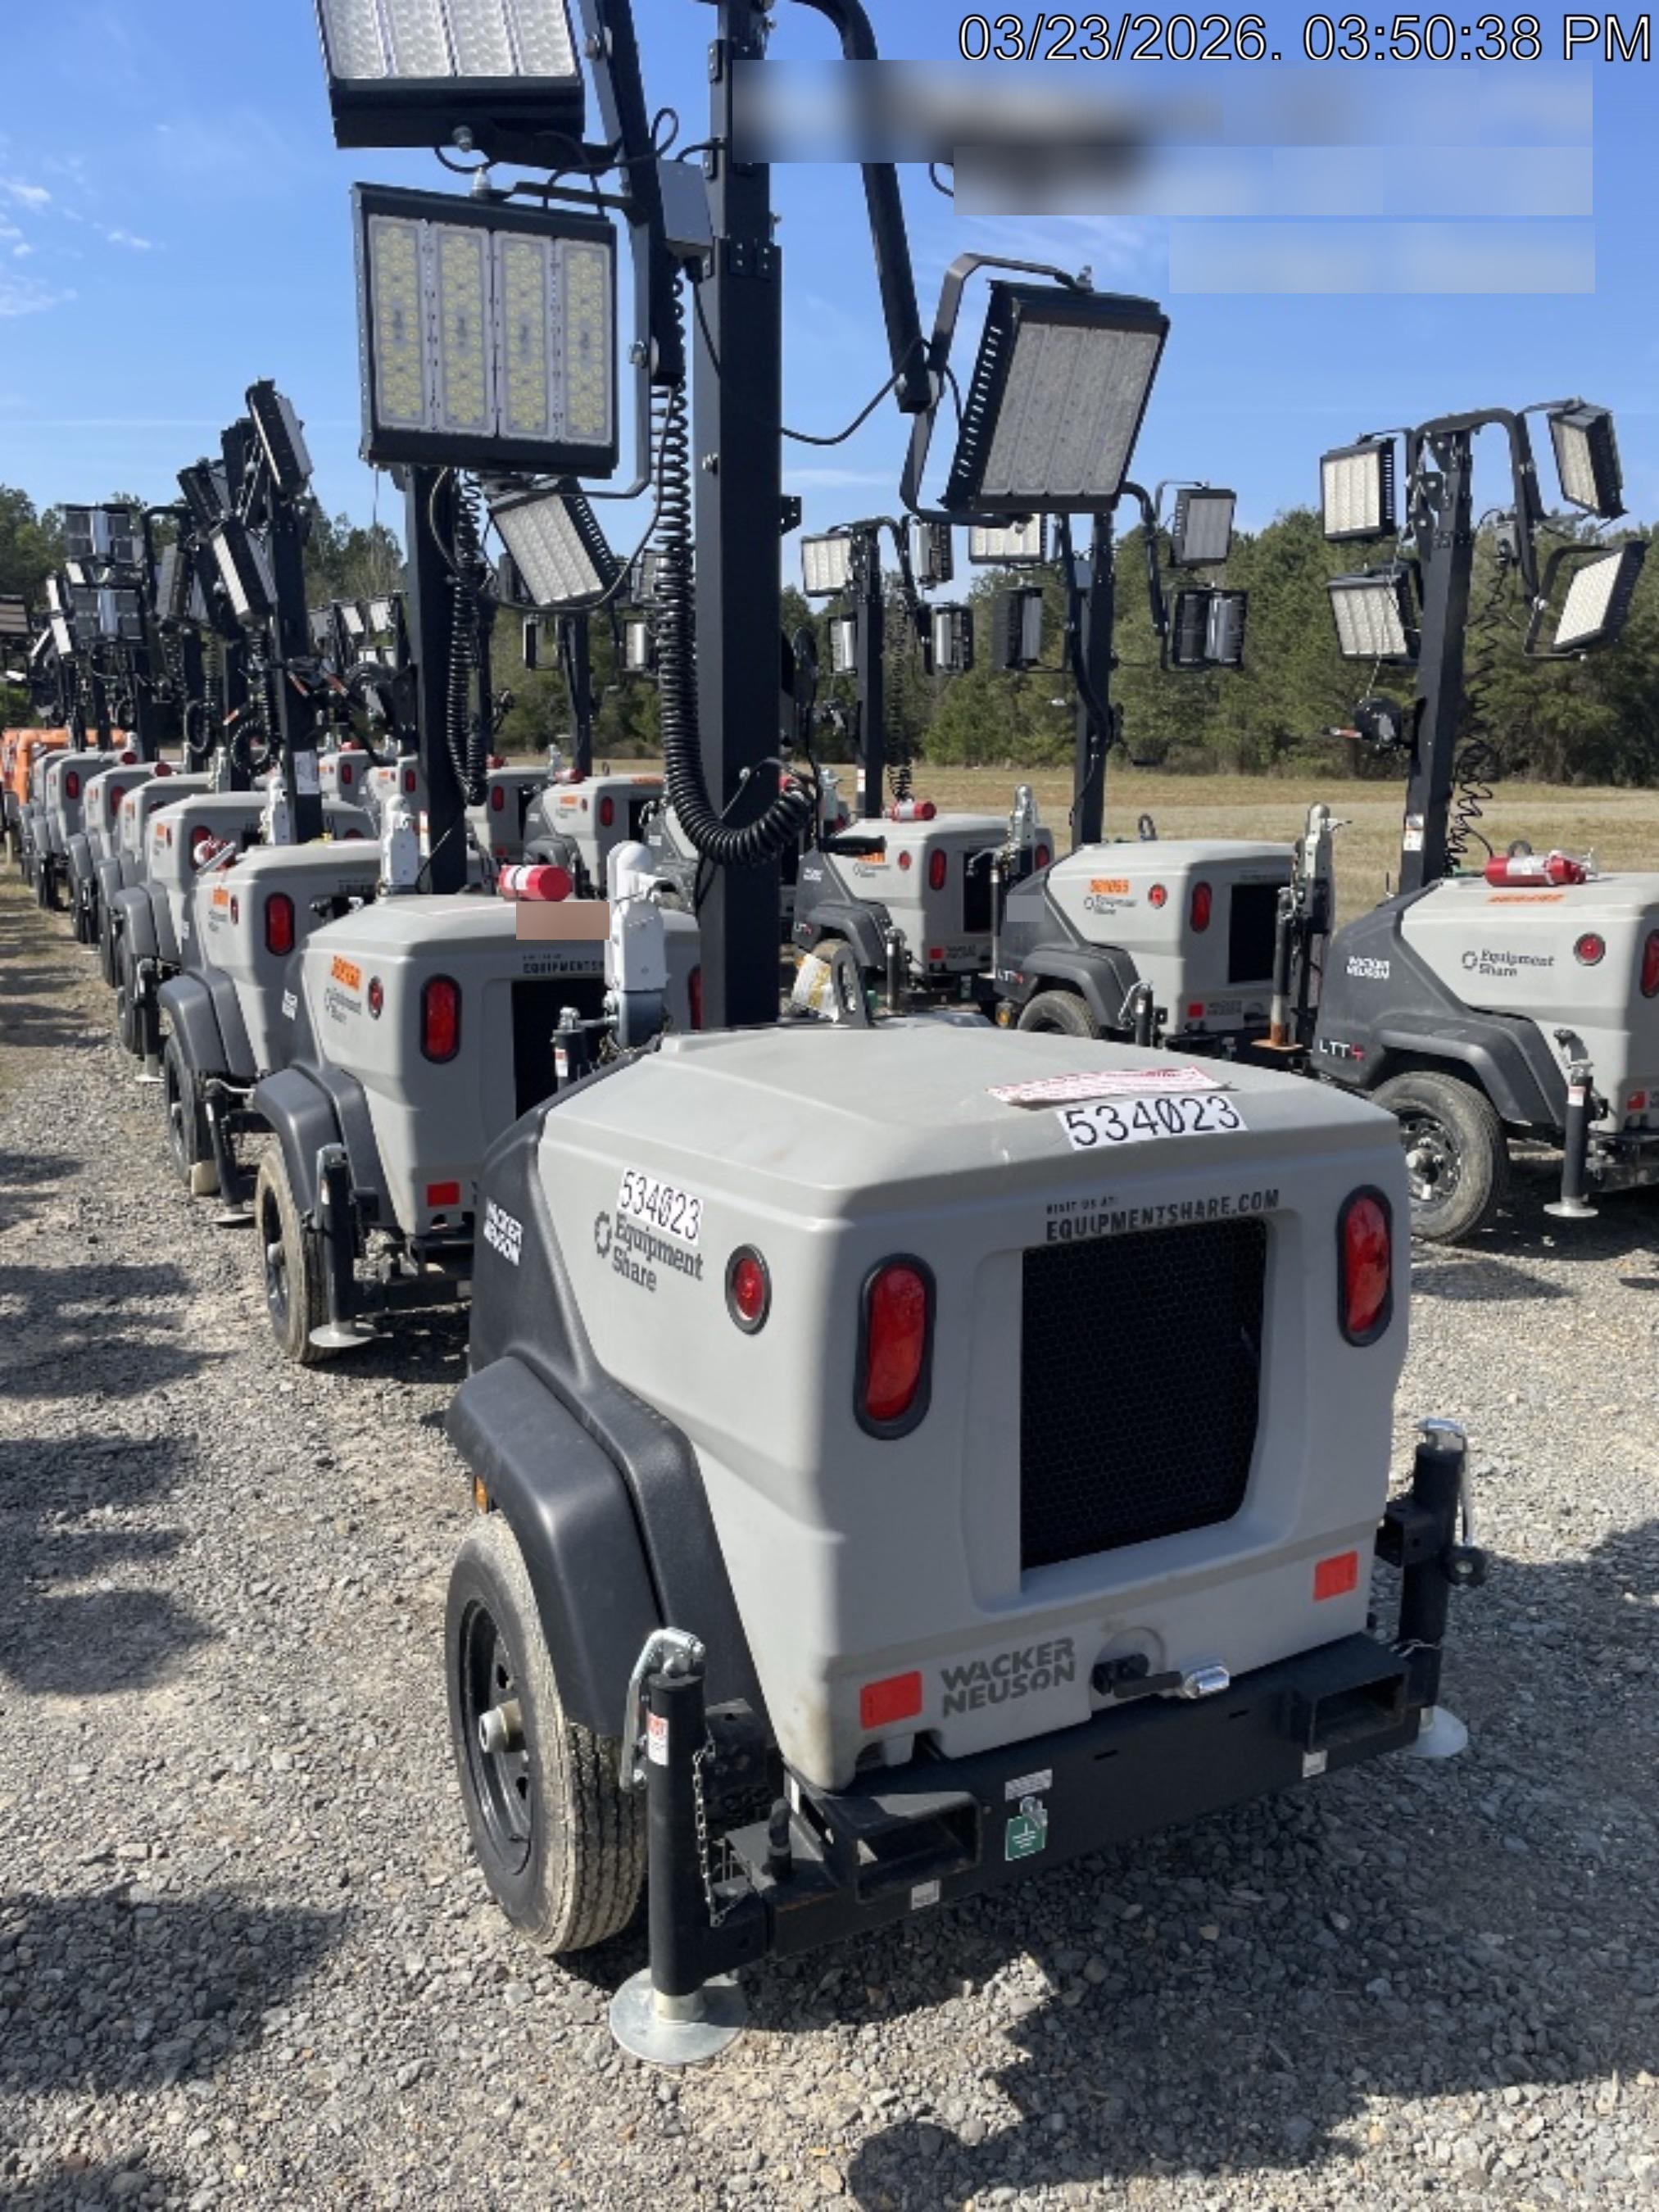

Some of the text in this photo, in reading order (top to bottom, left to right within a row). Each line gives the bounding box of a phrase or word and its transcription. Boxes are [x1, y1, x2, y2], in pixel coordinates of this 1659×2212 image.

[1065, 1095, 1240, 1146] 534023
[621, 1170, 700, 1240] 534023
[1046, 1189, 1280, 1242] EQUIPMENTSHARE.COM
[612, 1244, 657, 1293] Share
[615, 1211, 704, 1281] Equipment
[941, 1637, 1076, 1691] WACKER
[942, 1661, 1076, 1718] NEUSON
